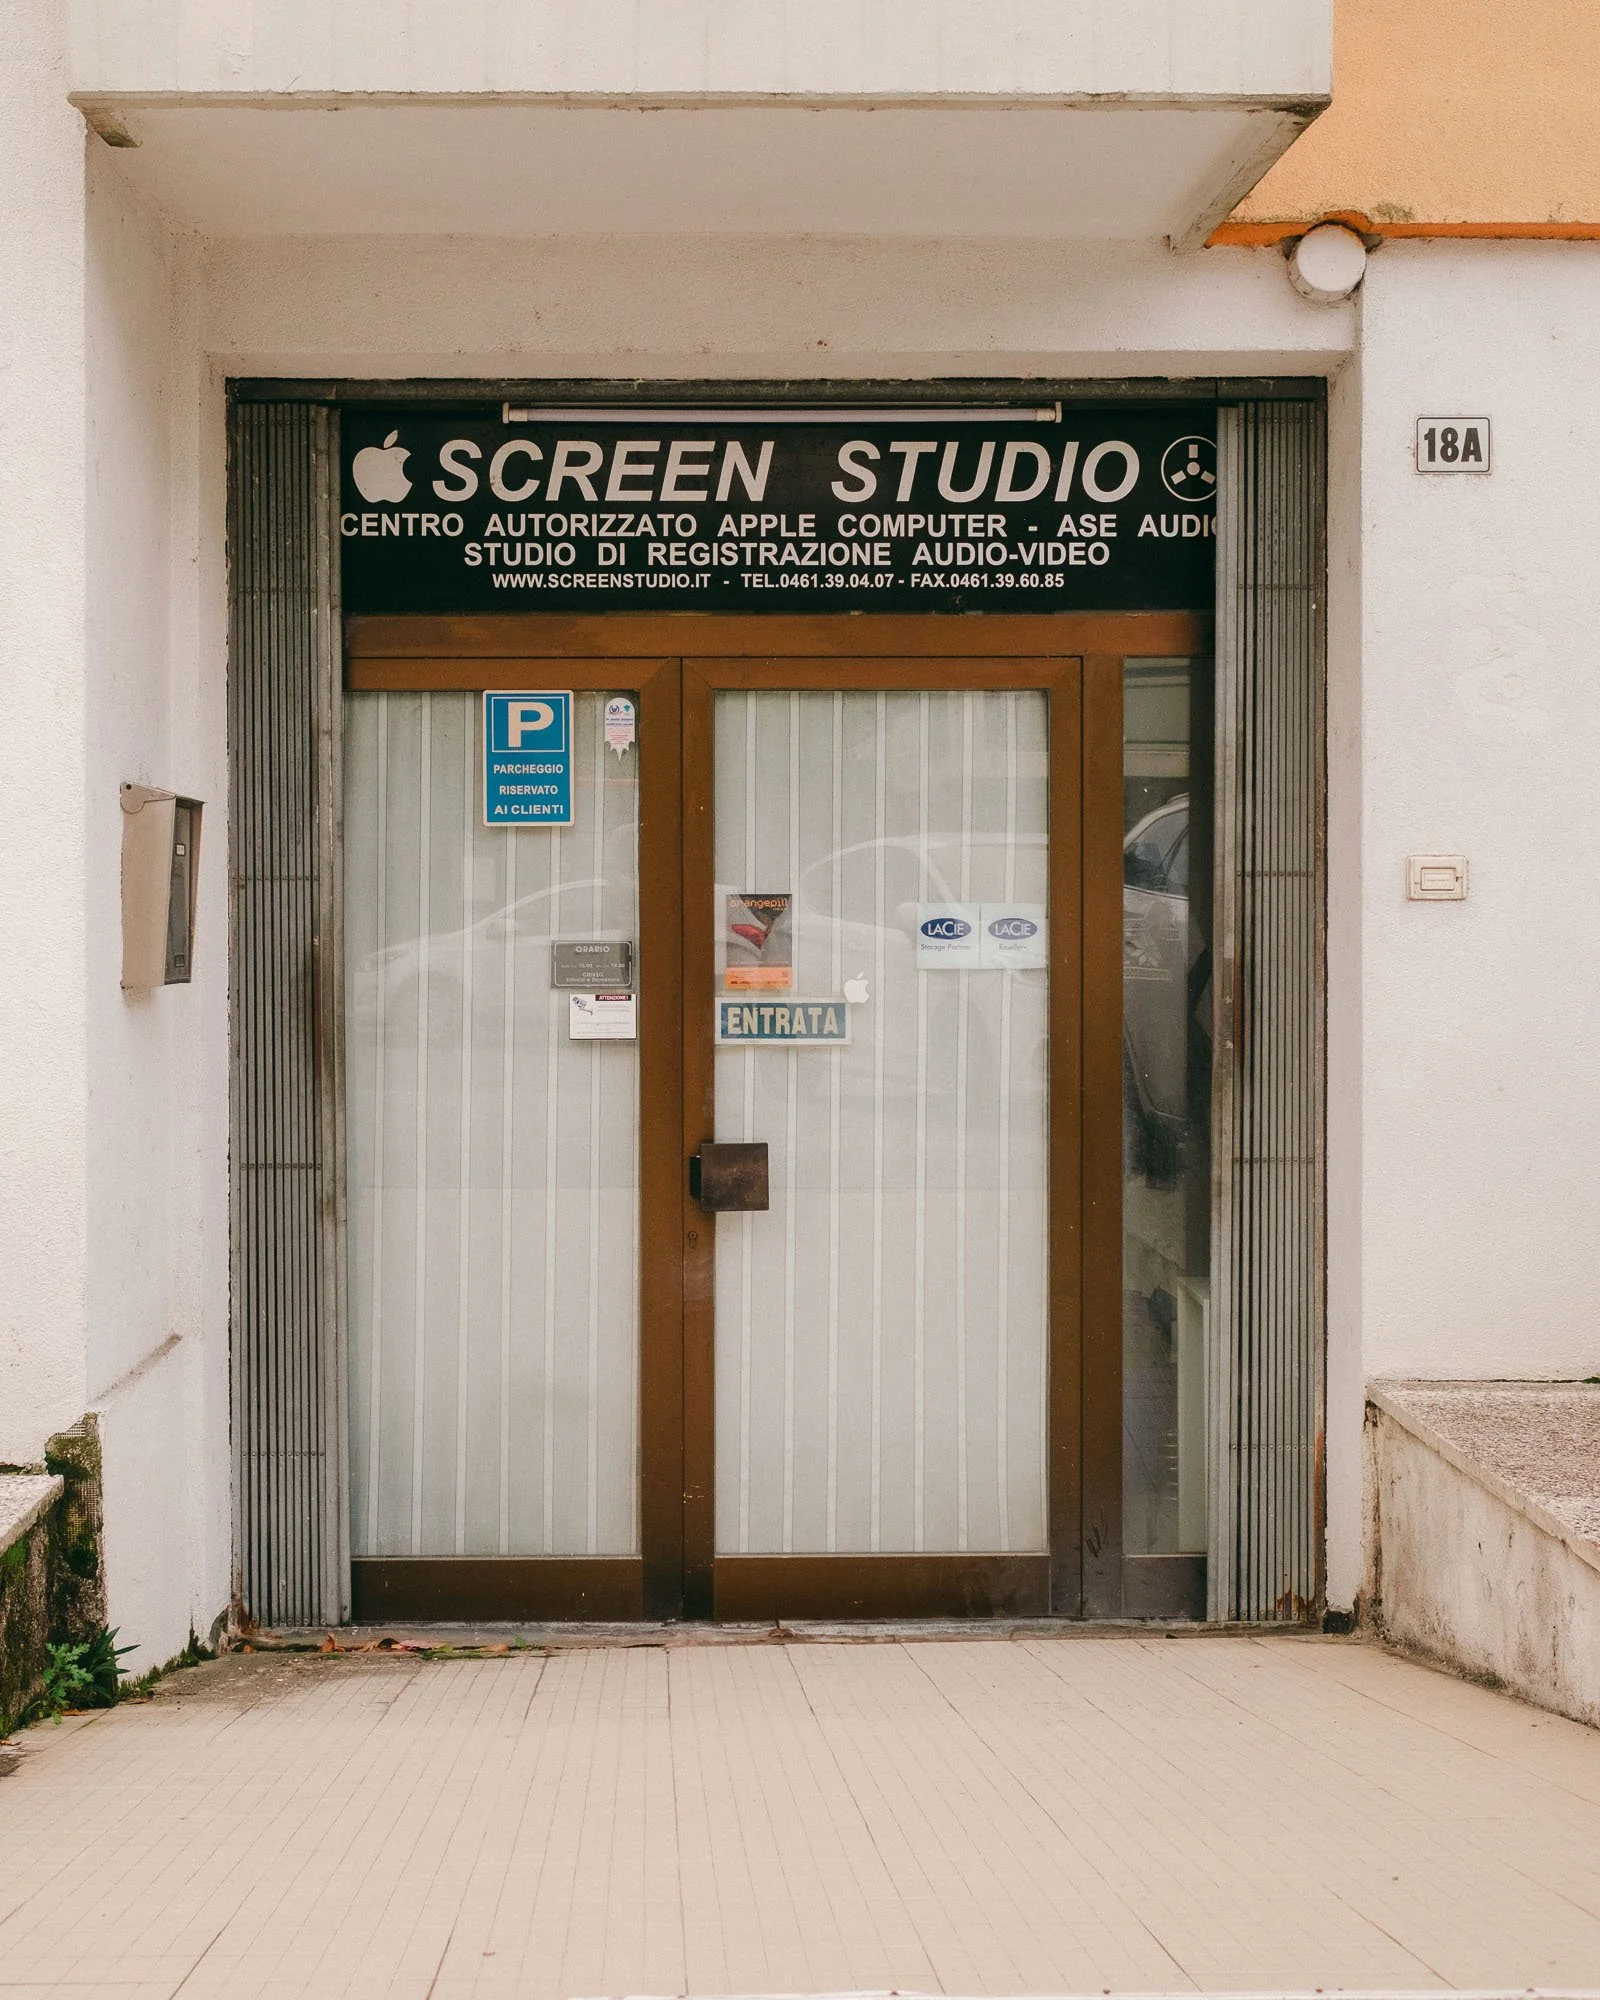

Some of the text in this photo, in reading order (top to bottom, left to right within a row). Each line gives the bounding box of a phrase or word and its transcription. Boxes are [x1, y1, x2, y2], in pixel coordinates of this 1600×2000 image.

[1423, 426, 1483, 463] 18A
[432, 439, 1140, 503] SCREEN STUDIO
[340, 512, 464, 538] CENTRO
[483, 513, 697, 538] AUTORIZZATO
[716, 513, 817, 538] APPLE
[837, 513, 1008, 538] COMPUTER
[1056, 513, 1118, 538] ASE
[1137, 514, 1217, 538] AUDI
[463, 541, 1110, 567] STUDIO DI REGISTRAZIONE AUDIO-VIDEO
[492, 573, 712, 589] WWW.SCREENSTUDIO.IT
[740, 573, 893, 589] TEL.0461.39.04.07
[910, 572, 1065, 588] FAX.0461.39.60.85
[508, 701, 555, 748] P
[493, 763, 564, 775] PARCHEGGIO
[499, 784, 559, 796] RISERVATO
[494, 804, 564, 815] AI CLIENTI
[728, 898, 789, 910] orangepill
[575, 945, 610, 953] ORARIO
[920, 943, 946, 952] Storage
[727, 1006, 840, 1035] ENTRATA
